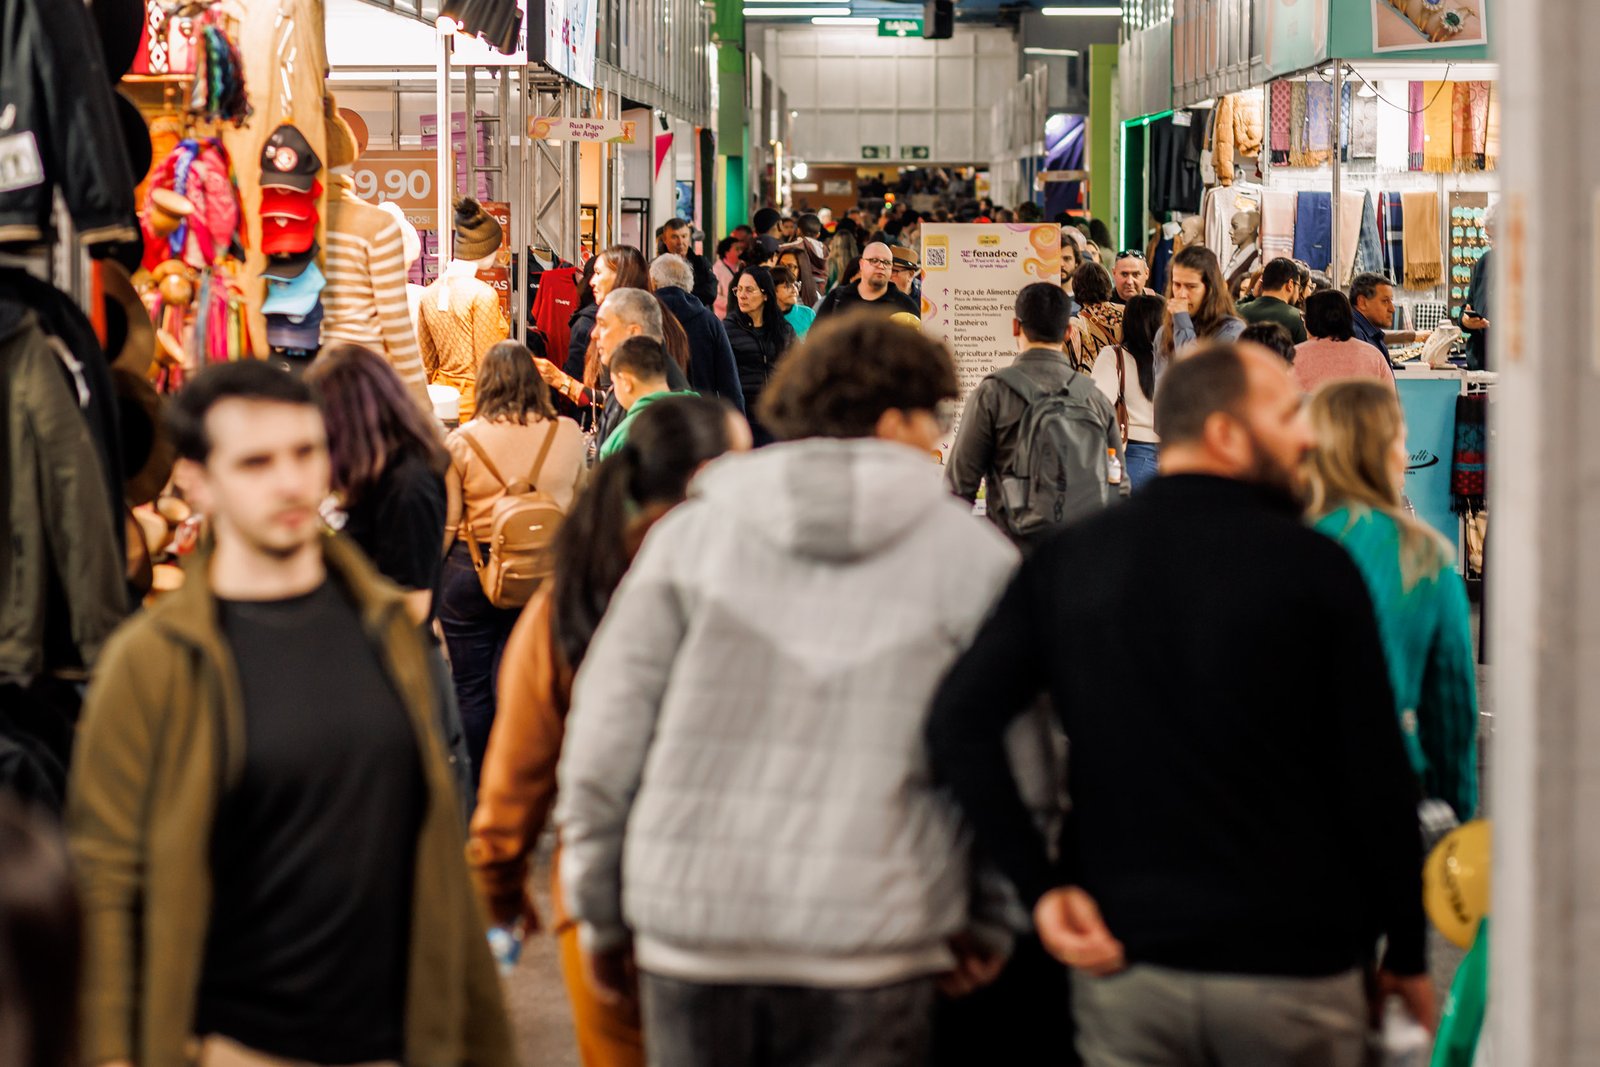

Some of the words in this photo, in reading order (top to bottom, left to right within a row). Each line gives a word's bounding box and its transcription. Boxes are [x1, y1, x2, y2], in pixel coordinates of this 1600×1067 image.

[569, 121, 584, 130] Rua
[585, 122, 605, 131] Papo
[582, 130, 599, 139] Anjo
[351, 168, 432, 204] 9,90
[973, 249, 1018, 258] fenadoce
[954, 288, 975, 297] Praça
[976, 288, 985, 296] de
[986, 288, 1018, 297] Alimentaç
[954, 303, 999, 312] Comunicação
[954, 335, 996, 343] Informações
[954, 350, 993, 358] Agricultura
